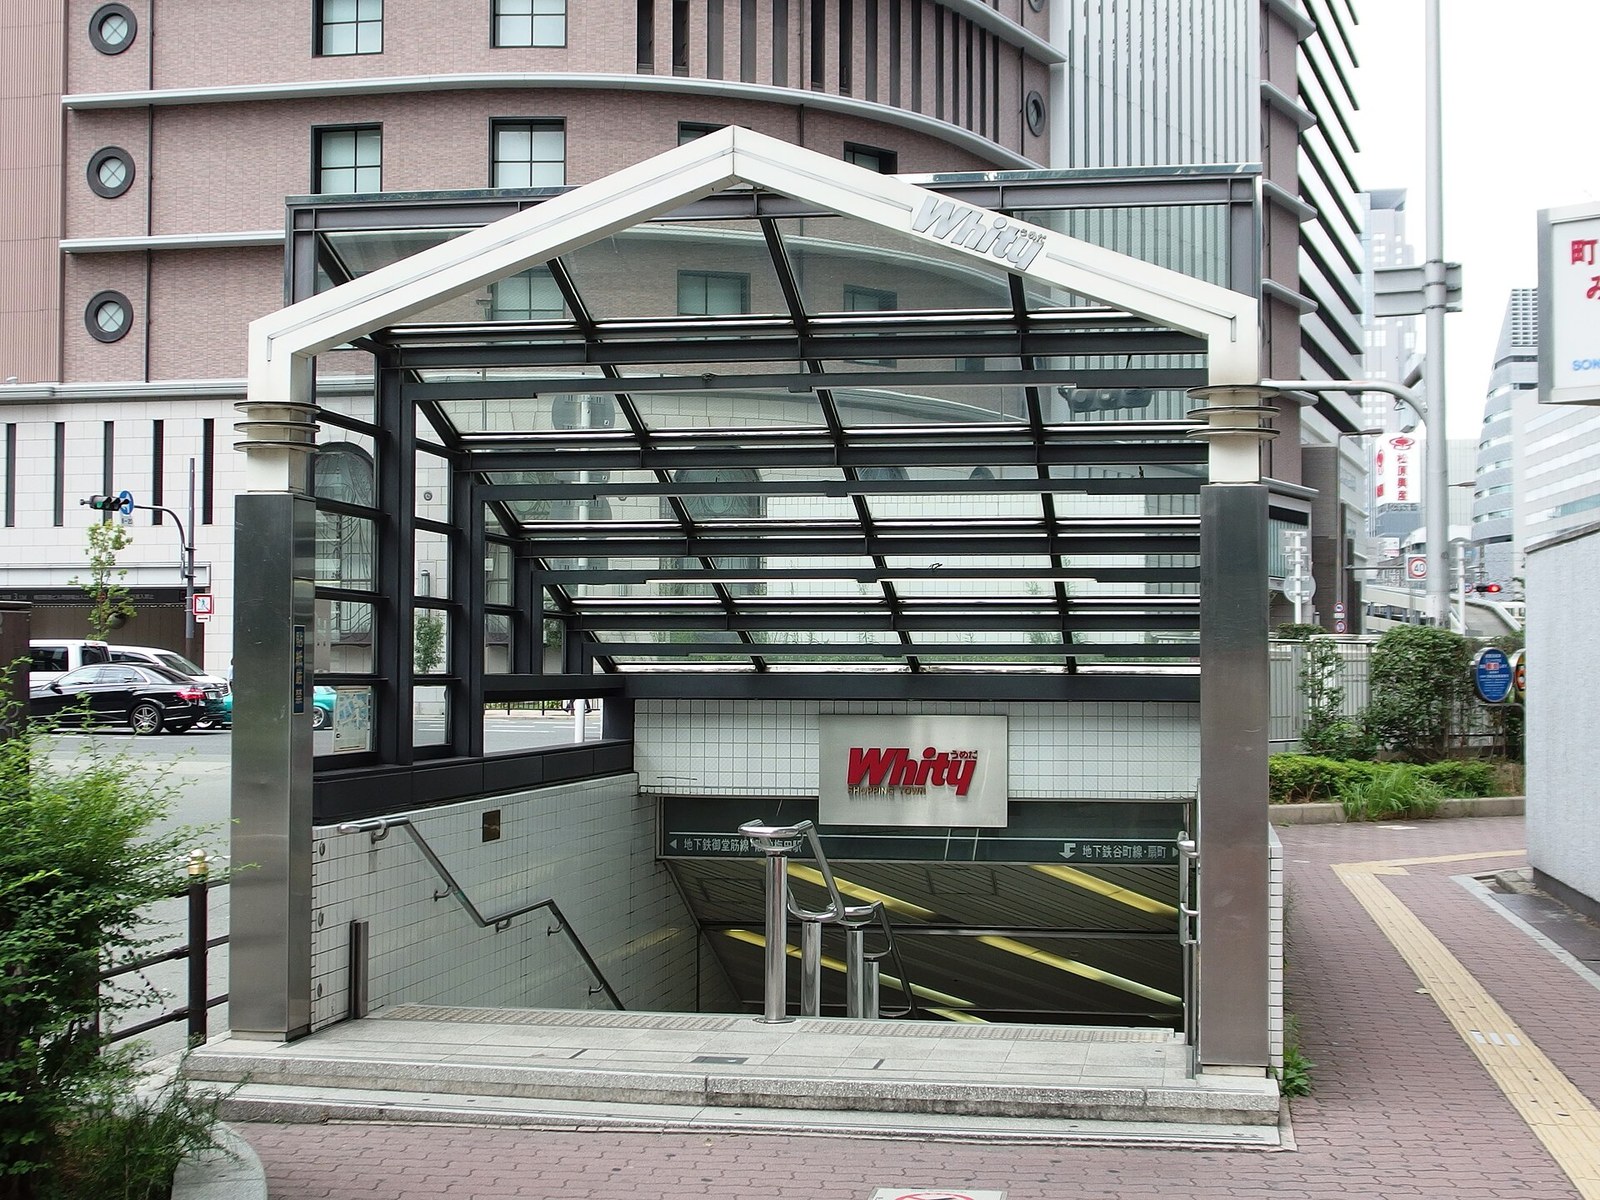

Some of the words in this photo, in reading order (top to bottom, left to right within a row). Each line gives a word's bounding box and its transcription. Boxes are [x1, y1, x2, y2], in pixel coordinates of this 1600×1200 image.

[912, 195, 1044, 271] Whity
[1413, 562, 1425, 573] 40
[950, 749, 978, 760] うめだ
[847, 746, 977, 796] Whity
[847, 786, 895, 796] SHOPPING
